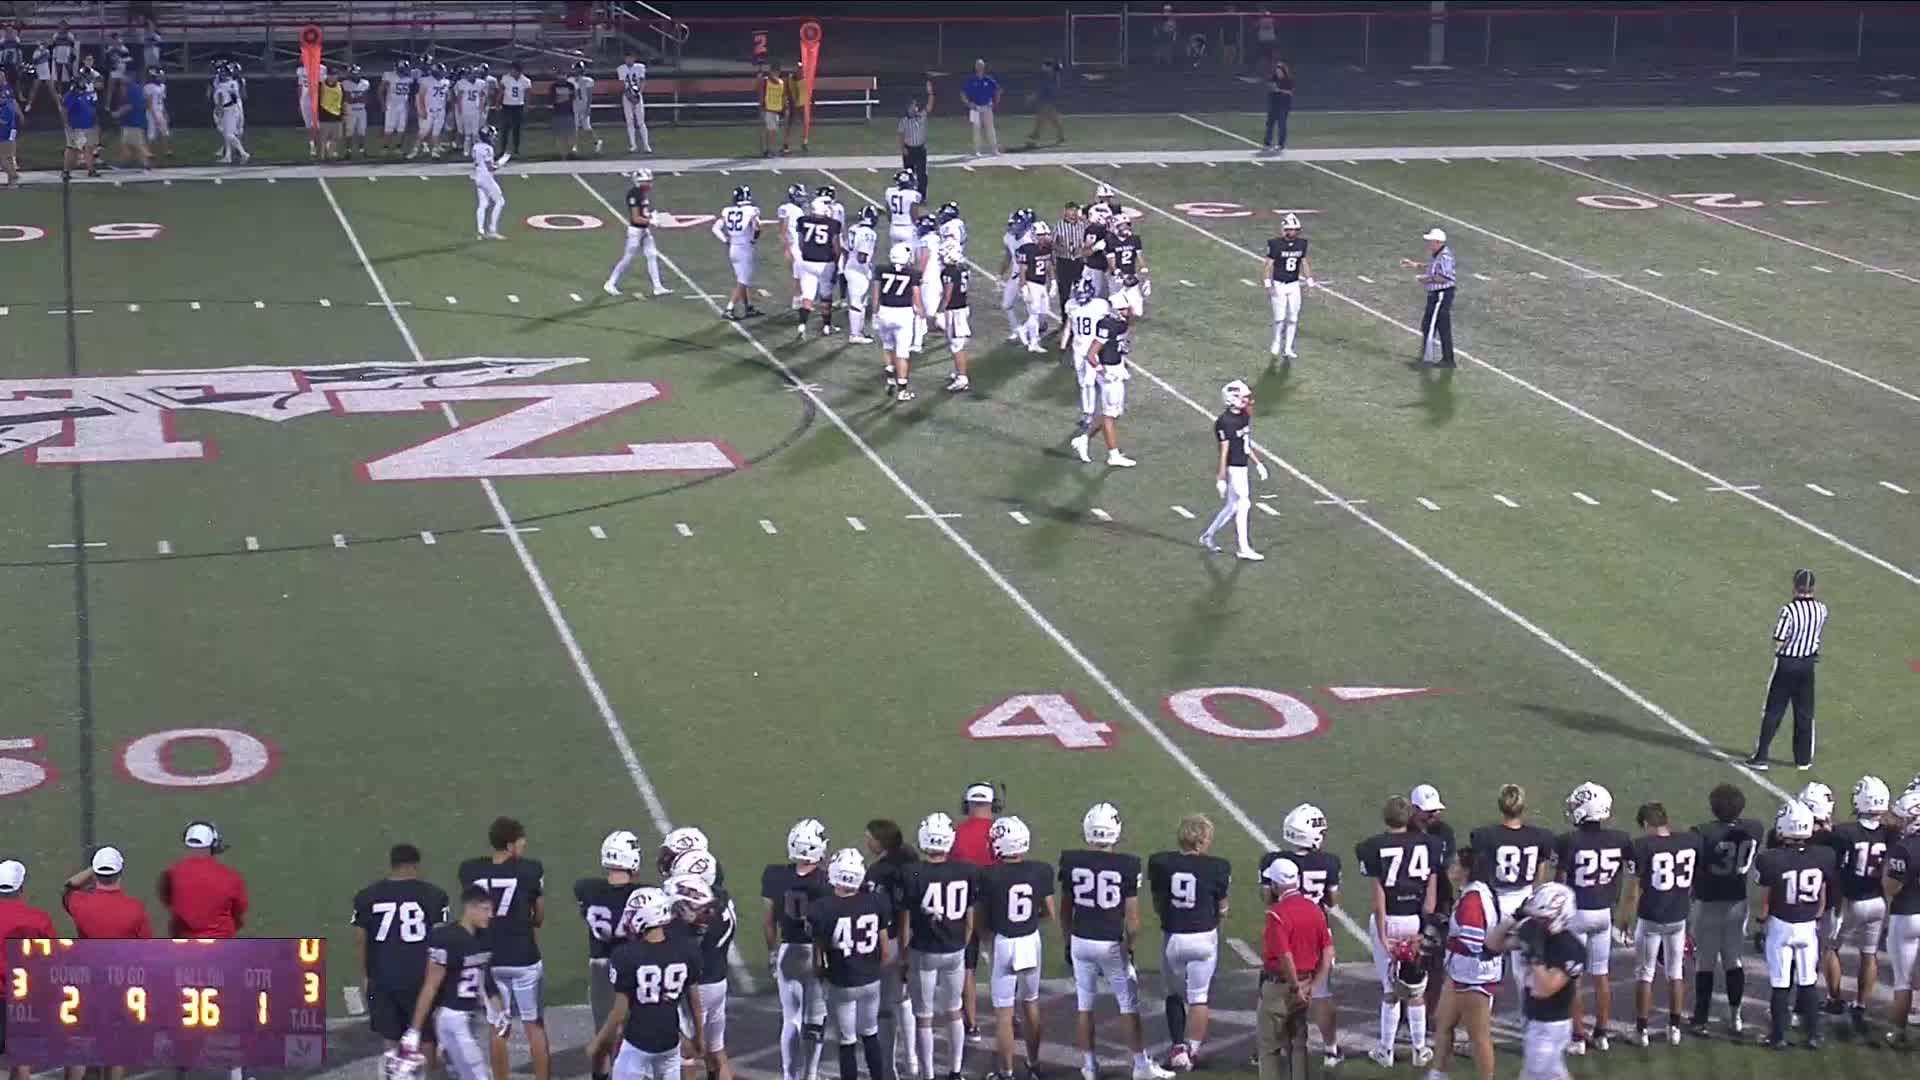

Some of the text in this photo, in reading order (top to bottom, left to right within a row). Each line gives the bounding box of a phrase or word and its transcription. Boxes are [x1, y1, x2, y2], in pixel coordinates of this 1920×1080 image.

[753, 34, 767, 54] 2
[727, 210, 744, 232] 52
[891, 194, 904, 215] 51
[802, 222, 829, 245] 75
[1121, 250, 1132, 265] 2
[881, 272, 911, 296] 77
[1076, 316, 1092, 336] 18
[966, 686, 1322, 749] 40
[1380, 846, 1431, 887] 74
[1496, 845, 1539, 883] 81
[1575, 848, 1622, 888] 25
[1651, 848, 1697, 891] 83
[1712, 840, 1757, 876] 30
[921, 880, 969, 920] 40
[1008, 883, 1033, 922] 6
[1071, 867, 1122, 909] 26
[1171, 872, 1197, 909] 9
[1782, 868, 1823, 904] 19
[372, 901, 426, 943] 78
[832, 913, 879, 957] 43
[636, 962, 688, 1004] 89
